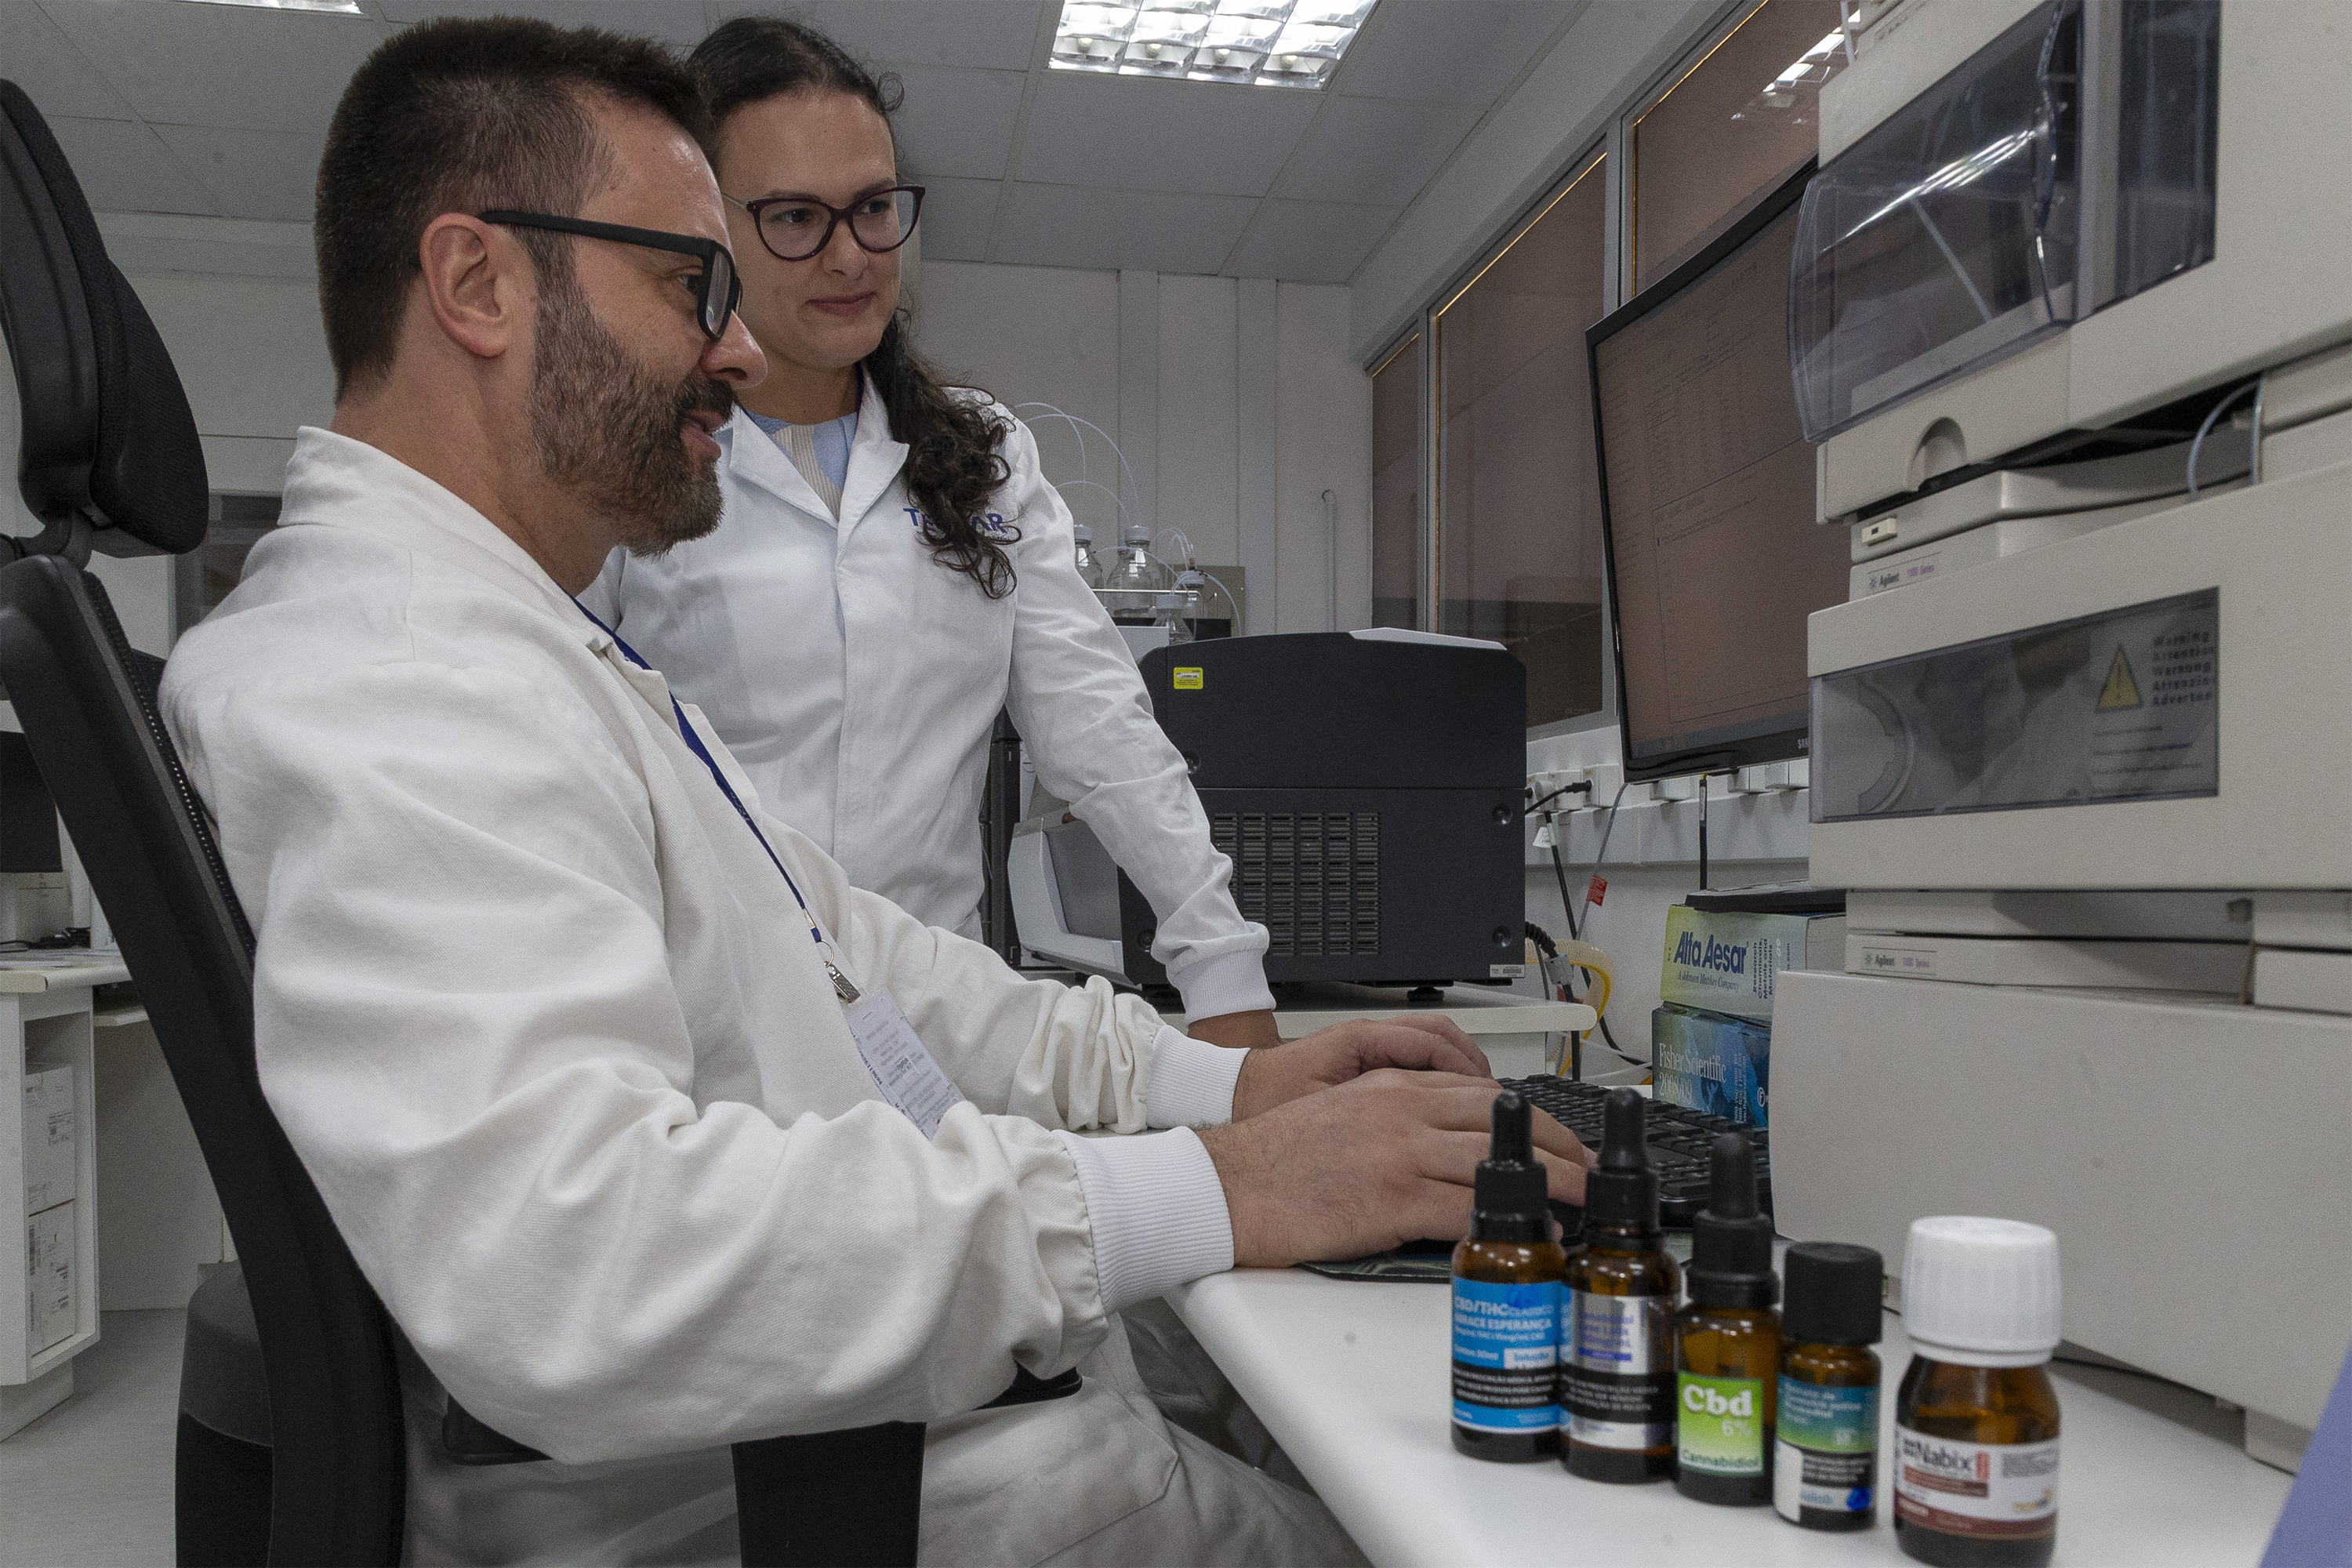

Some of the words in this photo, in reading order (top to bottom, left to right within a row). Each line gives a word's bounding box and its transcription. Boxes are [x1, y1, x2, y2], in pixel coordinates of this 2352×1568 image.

[903, 508, 1007, 534] TEAR
[1879, 572, 1900, 587] Agilent
[1673, 931, 1701, 967] Alfa
[1701, 934, 1748, 975] Aesar
[1875, 954, 1895, 967] Agilent
[1718, 977, 1740, 993] Company
[1659, 1043, 1684, 1072] Fisher
[1685, 1048, 1727, 1083] Scientific
[1487, 1318, 1552, 1331] ESPERANÇA
[1683, 1384, 1754, 1417] Cbd
[1721, 1418, 1754, 1438] 6%
[1682, 1448, 1760, 1468] Cannabidiol
